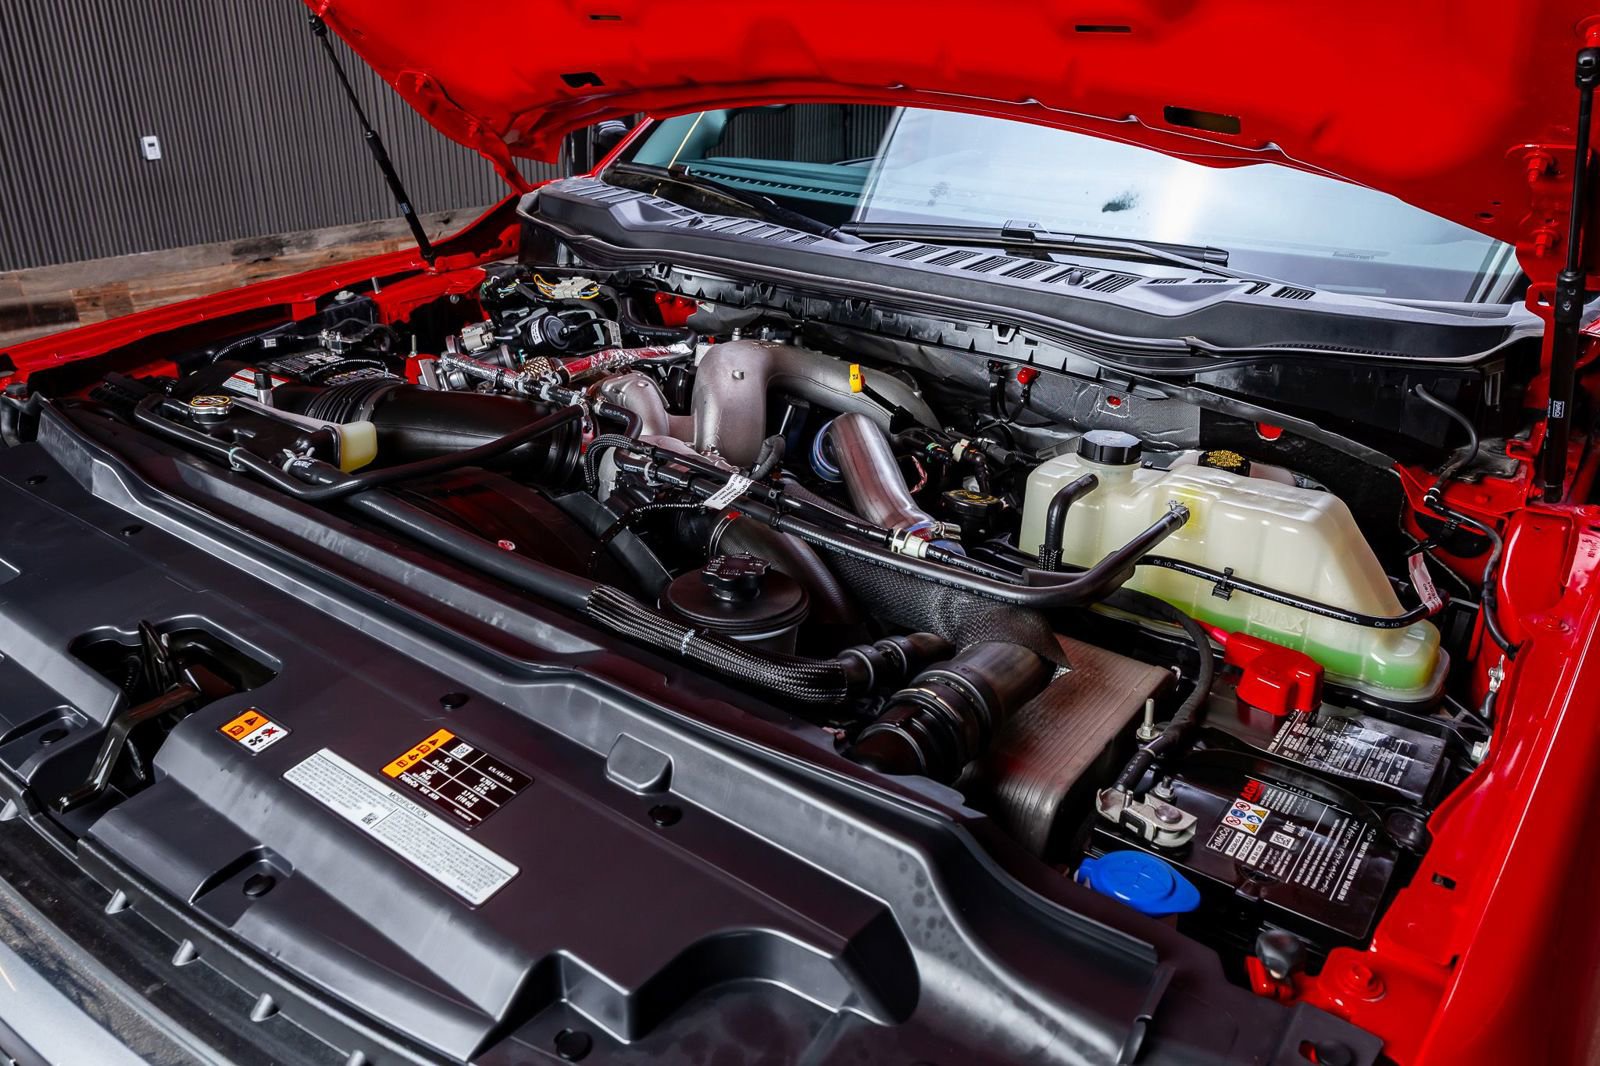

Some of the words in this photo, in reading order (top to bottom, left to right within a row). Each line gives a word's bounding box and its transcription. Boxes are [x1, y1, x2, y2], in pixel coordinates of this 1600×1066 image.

[1240, 779, 1259, 801] AGM
[389, 791, 429, 819] MODIFICATION
[1211, 827, 1230, 850] FoMoCo
